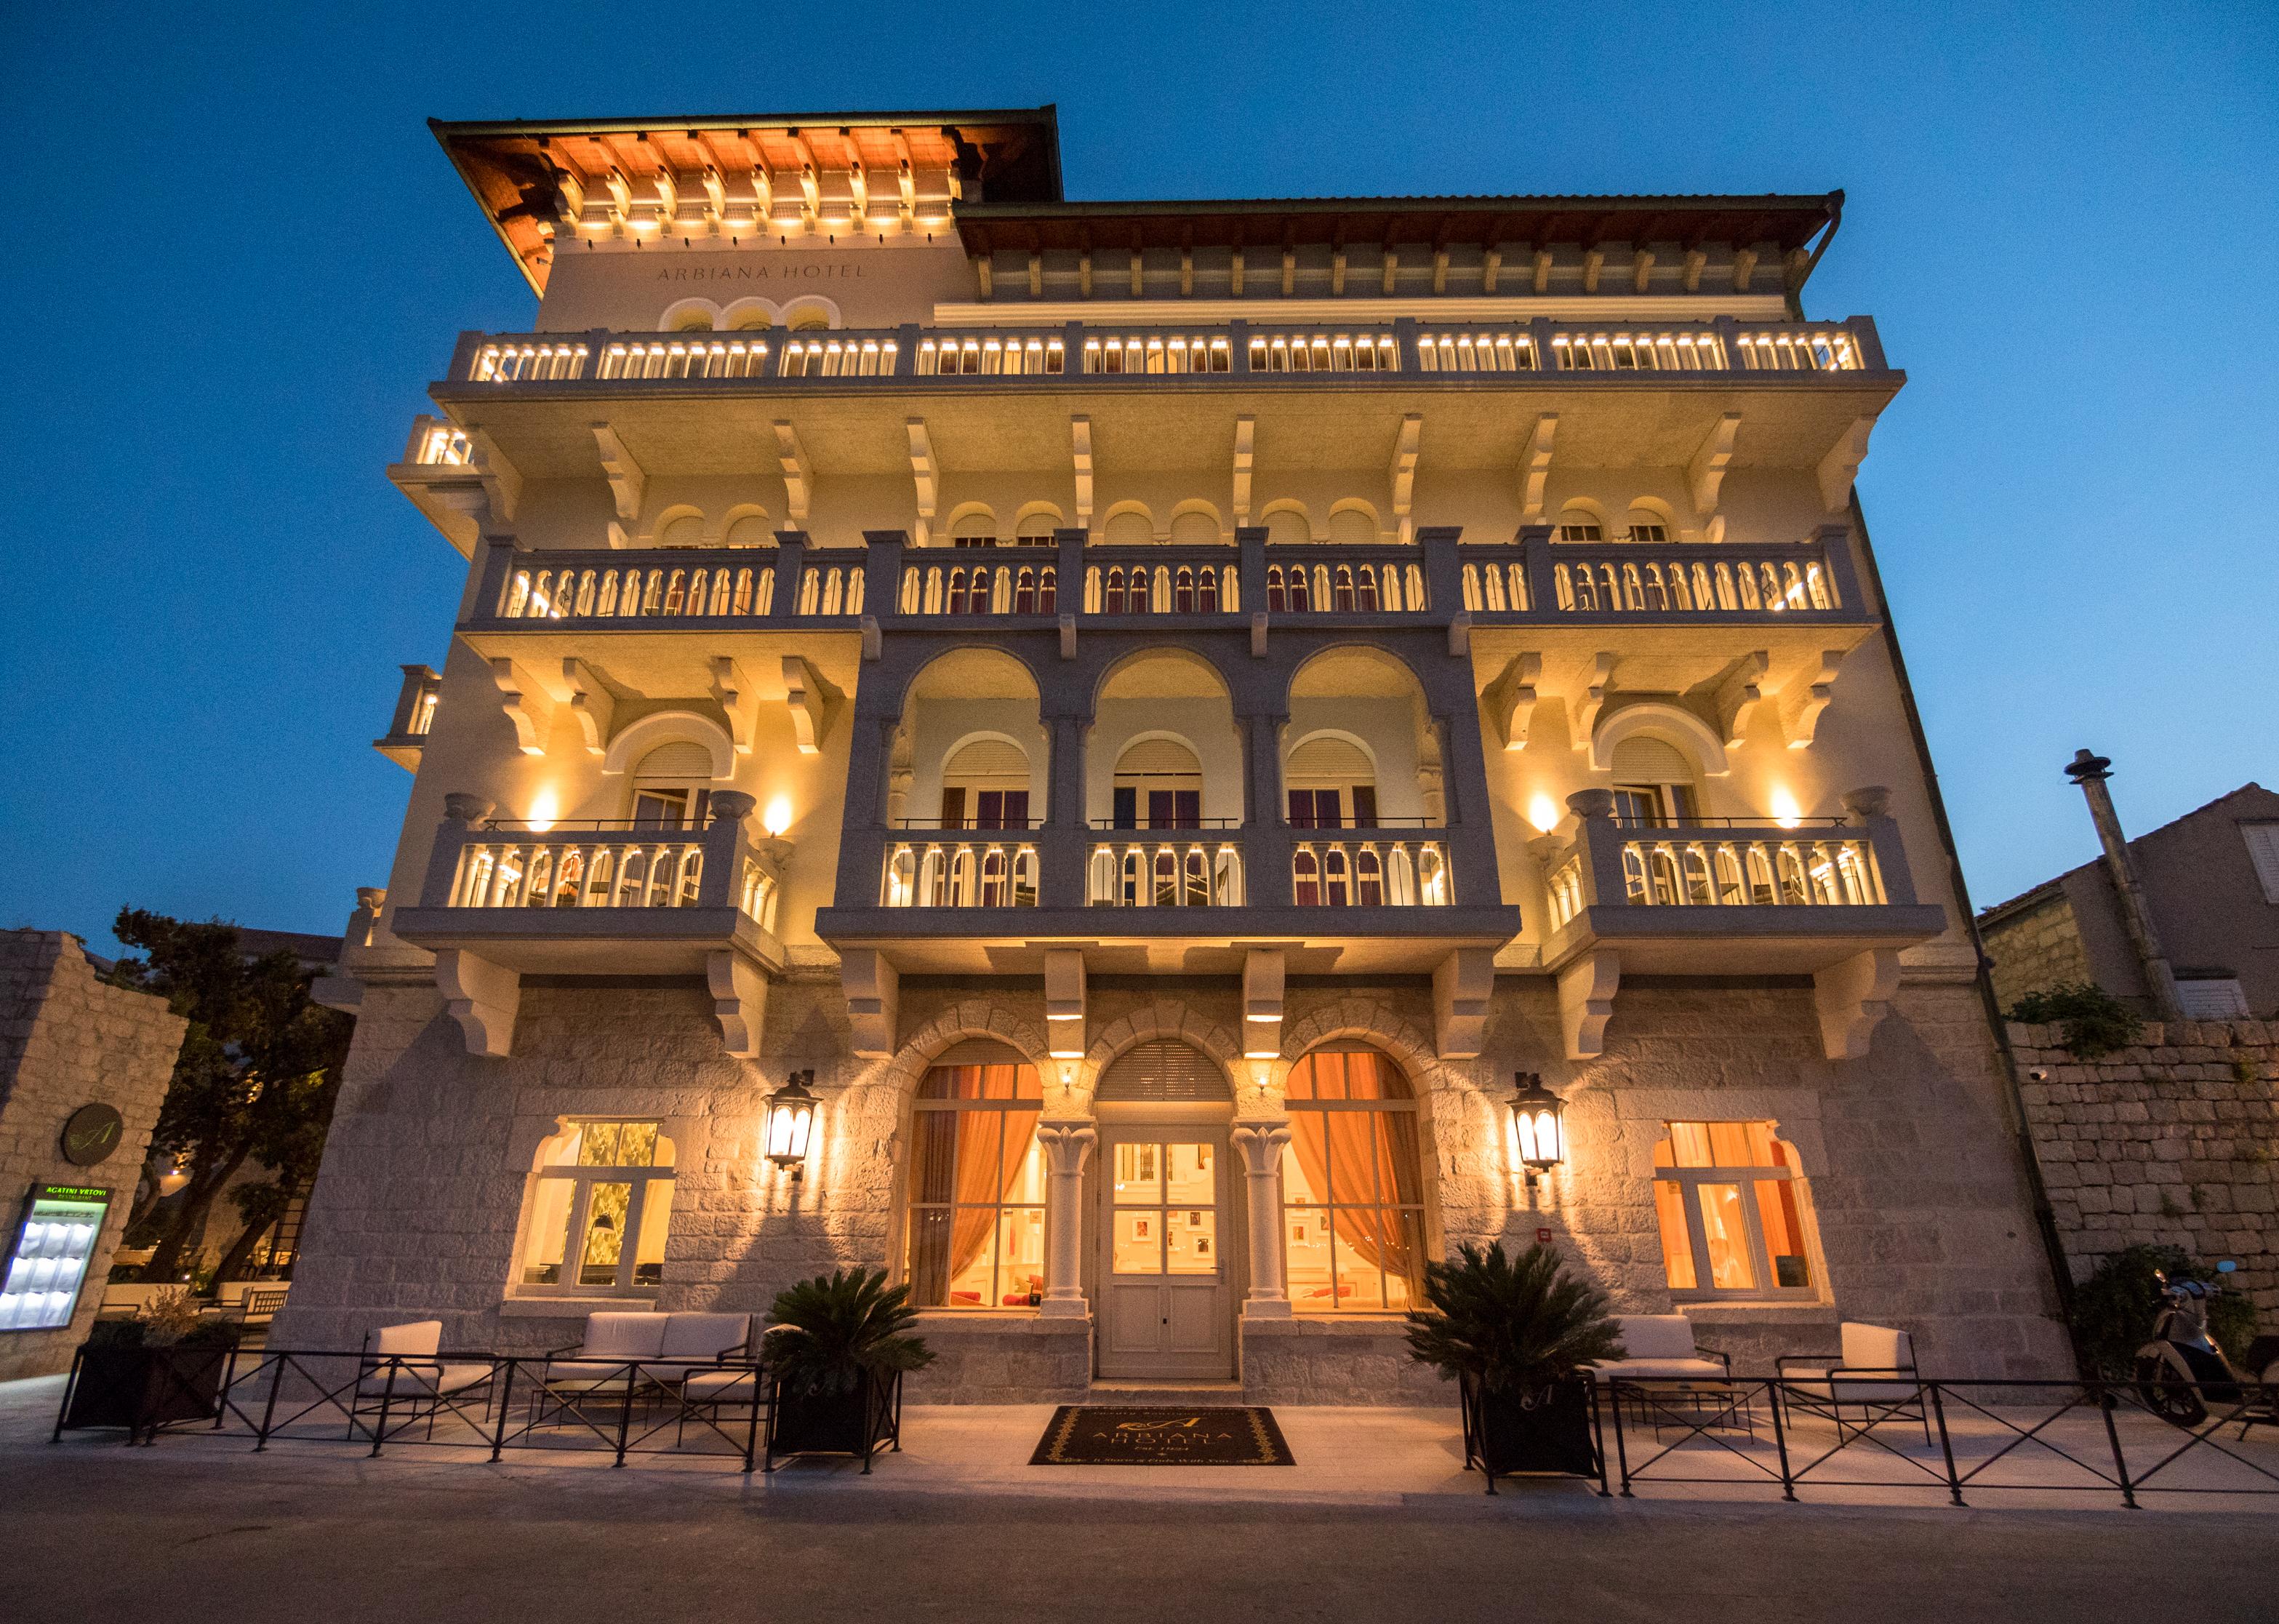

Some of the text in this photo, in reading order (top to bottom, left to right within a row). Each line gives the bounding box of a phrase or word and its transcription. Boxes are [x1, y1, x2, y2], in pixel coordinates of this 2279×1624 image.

[657, 264, 867, 281] ARBIANA HOTEL
[79, 1188, 106, 1196] VRTOVI
